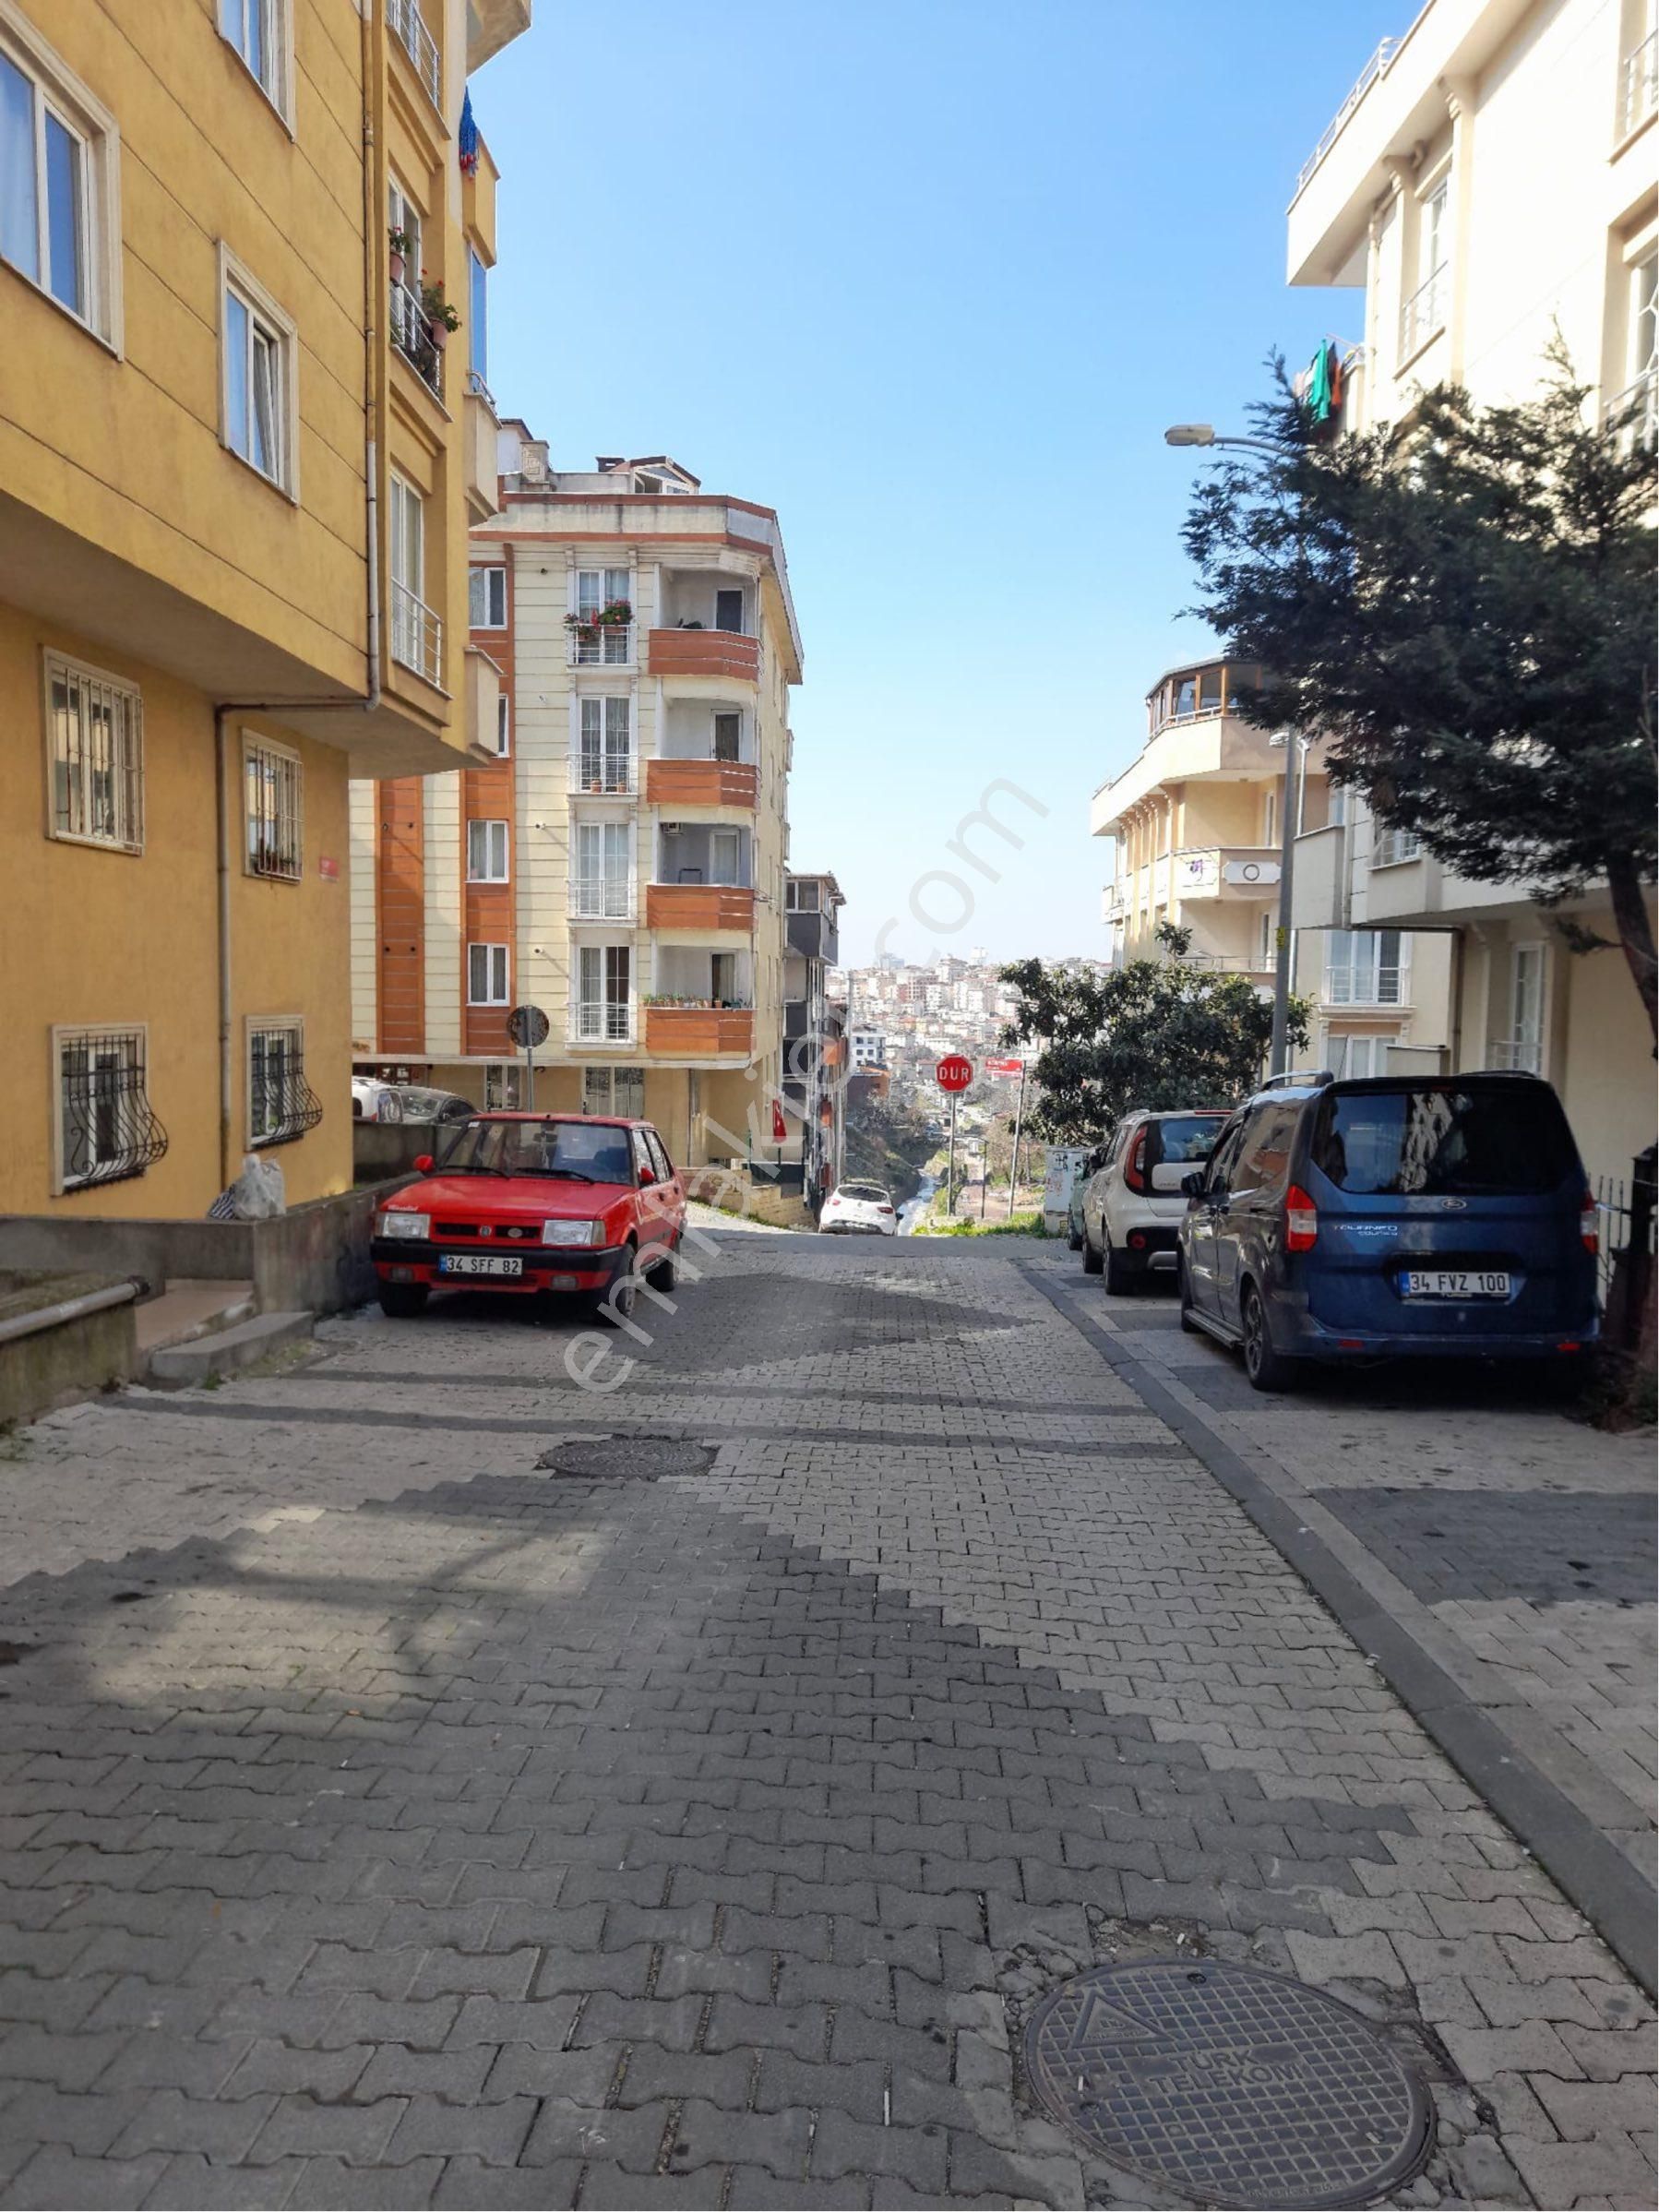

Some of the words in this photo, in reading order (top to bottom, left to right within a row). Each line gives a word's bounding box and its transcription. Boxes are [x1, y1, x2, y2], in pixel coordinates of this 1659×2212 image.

[938, 1067, 969, 1081] DUR
[448, 1257, 463, 1271] 34
[471, 1259, 494, 1272] SFF
[502, 1261, 519, 1273] 82
[1411, 1273, 1430, 1291] 34
[1438, 1274, 1469, 1291] FVZ
[1477, 1275, 1506, 1292] 100
[1169, 2050, 1260, 2073] TÜRK
[1149, 2063, 1304, 2094] TELEKOM
